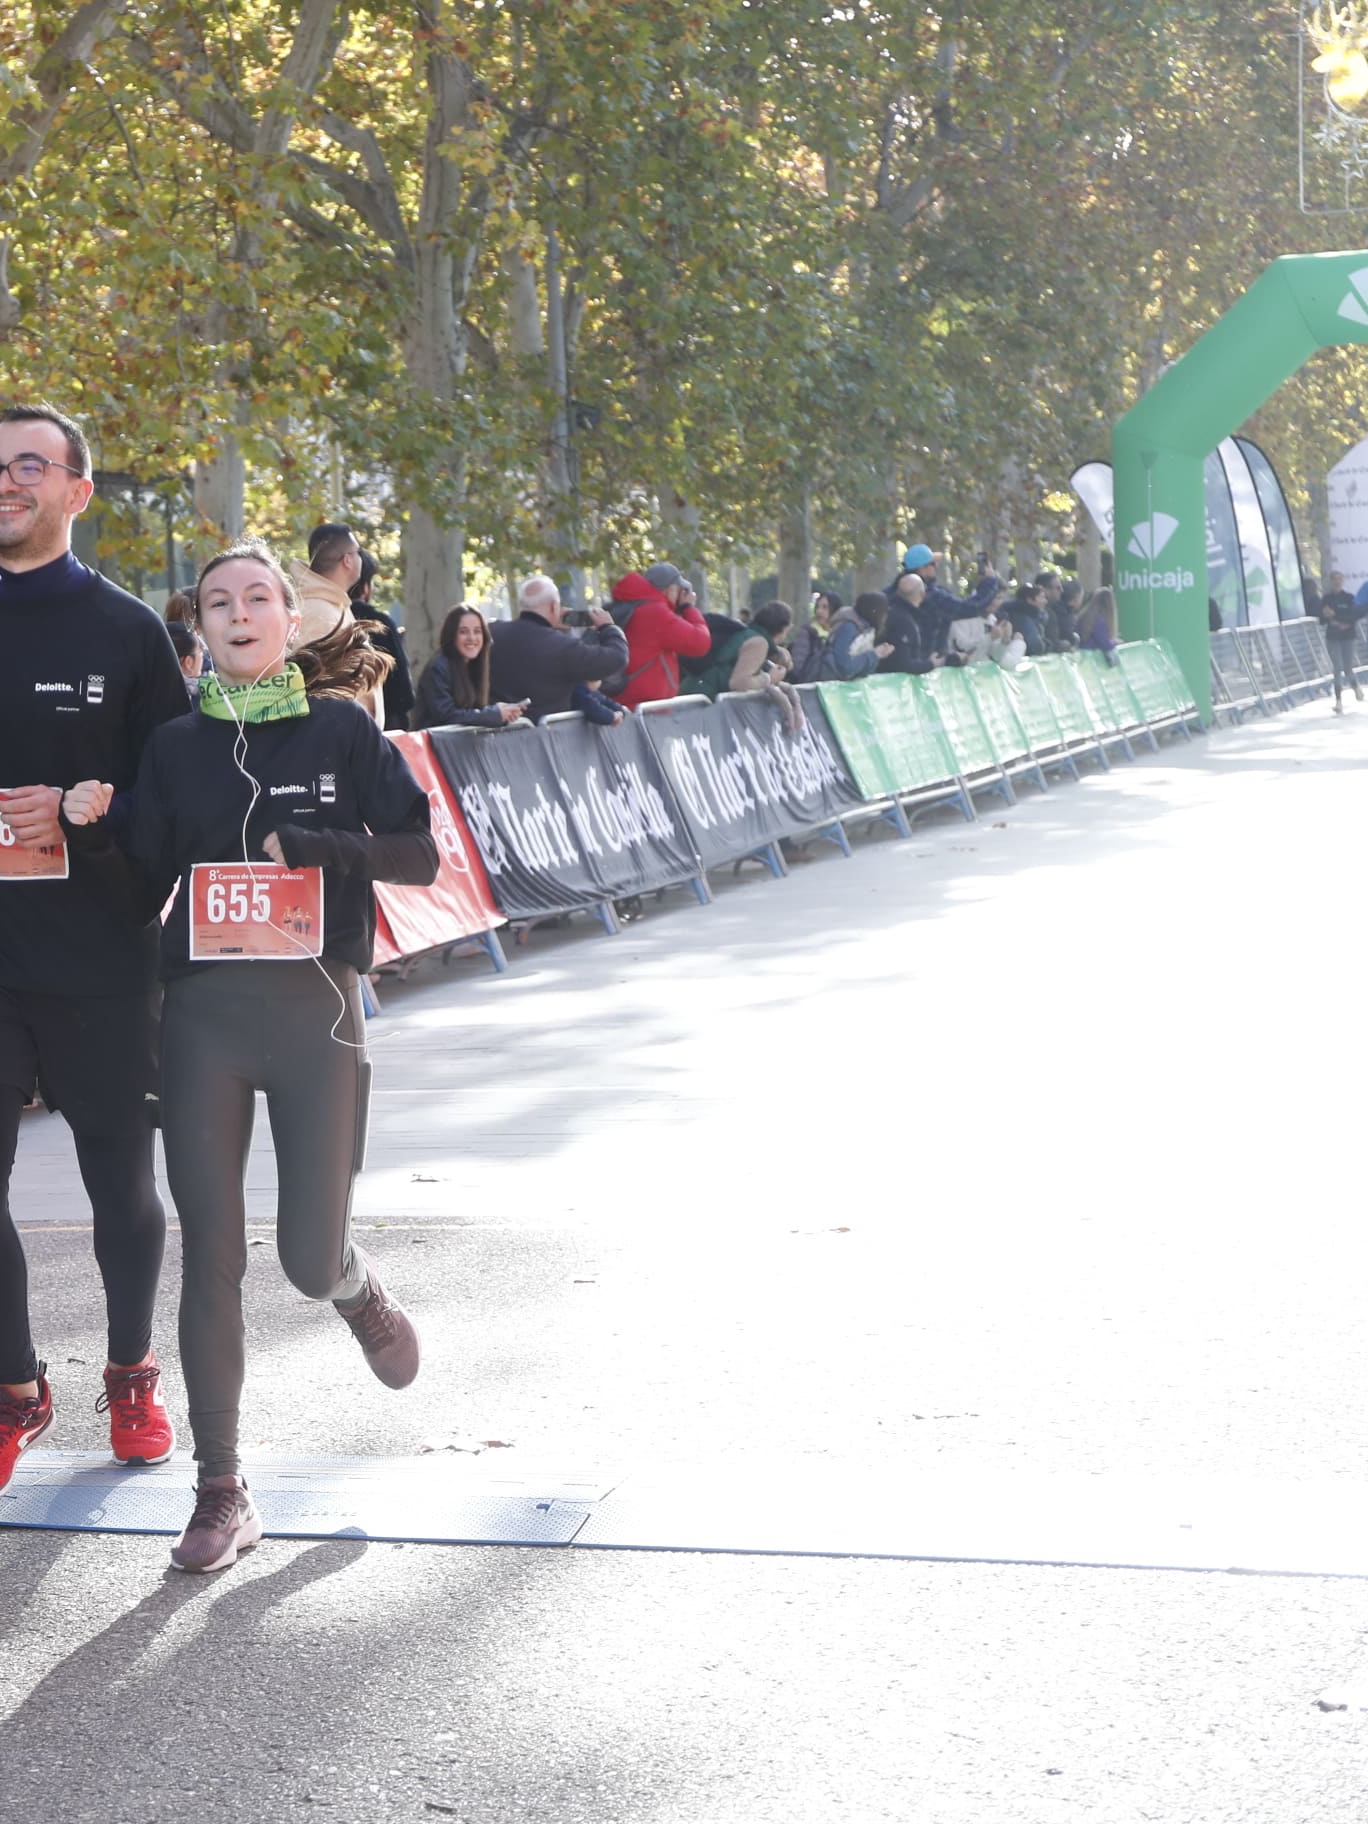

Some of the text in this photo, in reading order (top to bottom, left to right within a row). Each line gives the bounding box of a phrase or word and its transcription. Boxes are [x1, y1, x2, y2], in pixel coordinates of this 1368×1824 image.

[1118, 566, 1195, 593] Unicaja
[270, 784, 308, 796] Deloitte.
[207, 883, 271, 923] 655
